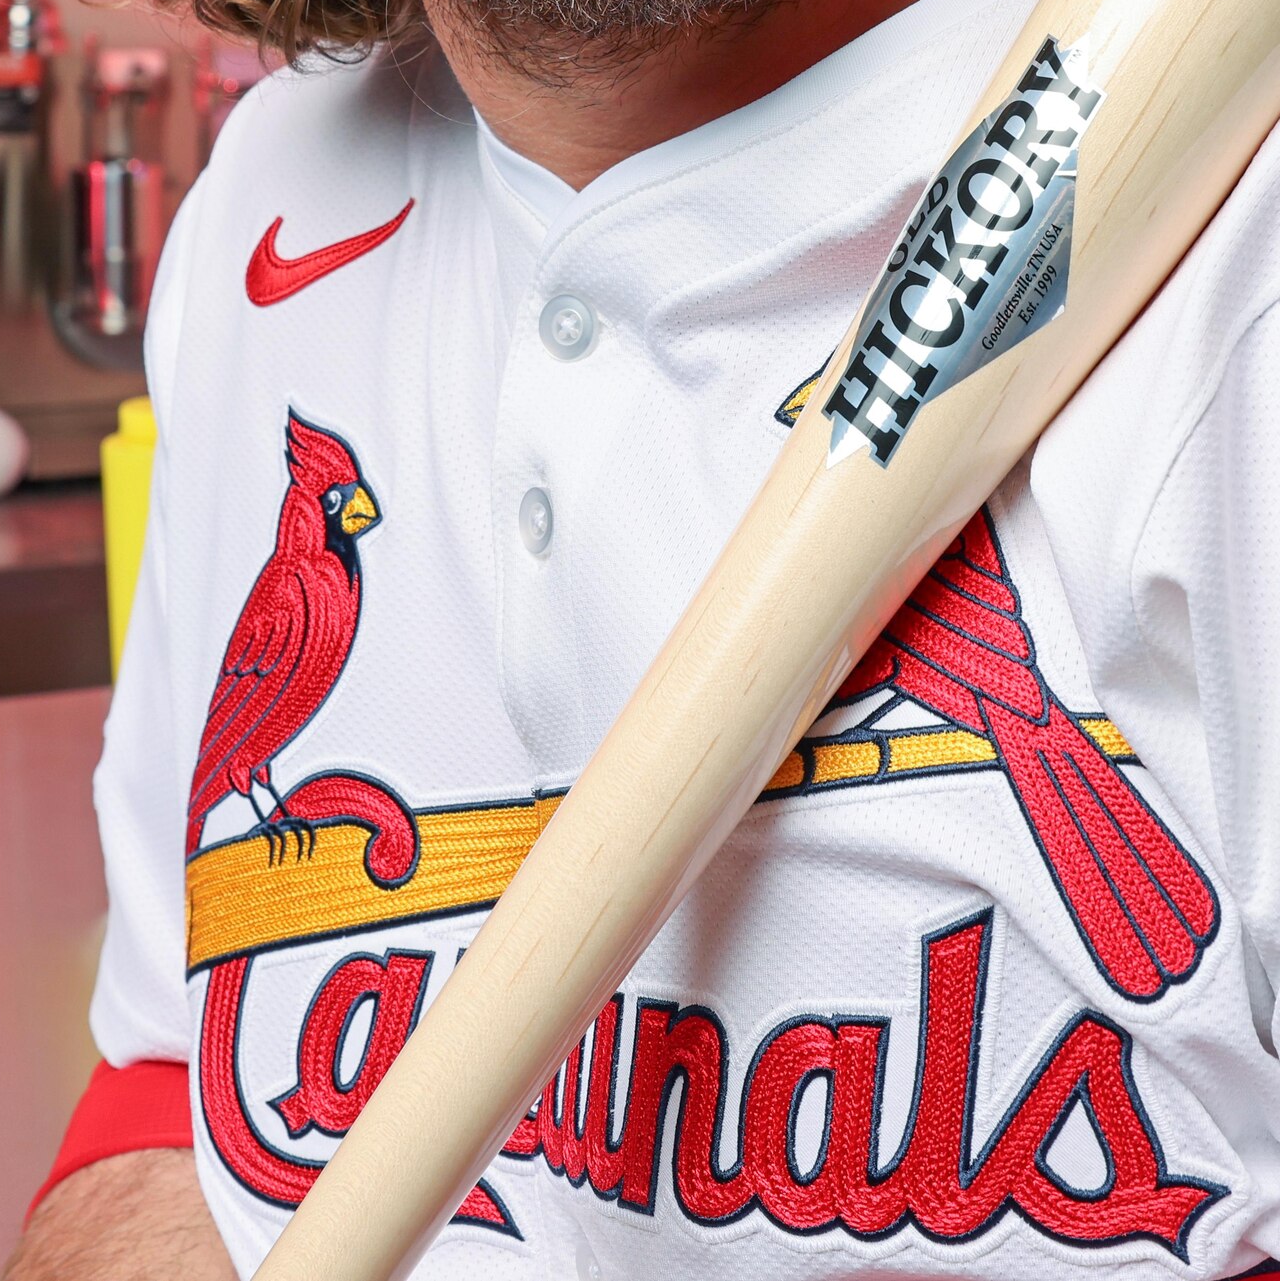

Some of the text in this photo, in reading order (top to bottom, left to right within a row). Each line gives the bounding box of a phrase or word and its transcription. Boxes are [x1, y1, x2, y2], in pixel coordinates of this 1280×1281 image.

[825, 35, 1106, 466] HICKORY
[887, 176, 949, 273] OLD
[981, 223, 1064, 350] Goodlettsville, TN USA
[1018, 264, 1057, 326] Est. 1999
[198, 770, 1231, 1265] Cainals
